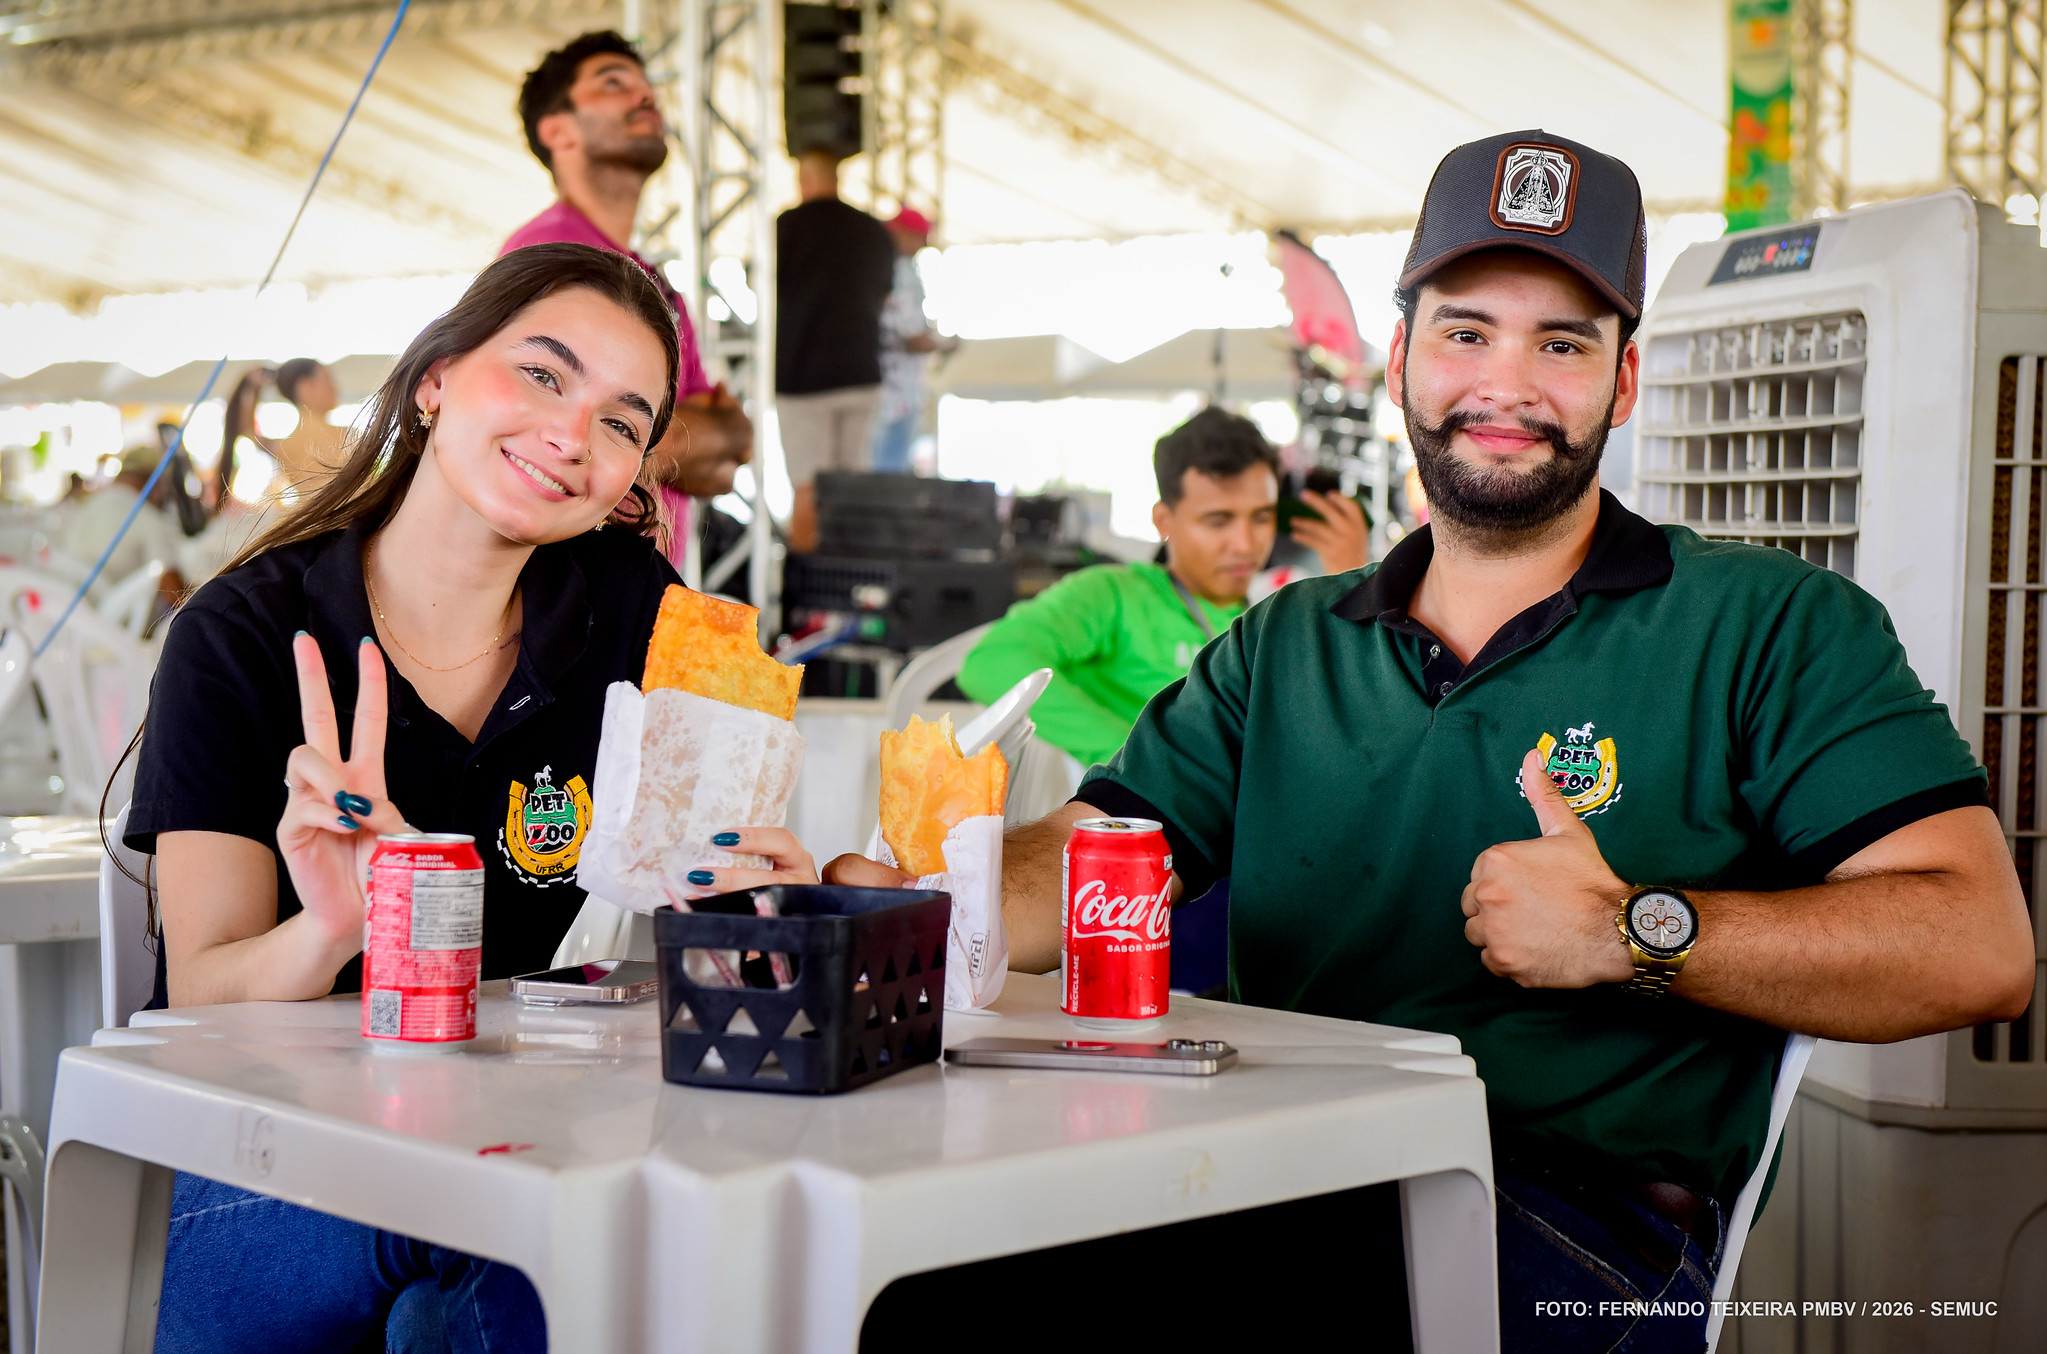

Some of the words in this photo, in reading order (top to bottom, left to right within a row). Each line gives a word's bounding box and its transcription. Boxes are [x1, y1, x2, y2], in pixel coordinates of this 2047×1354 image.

[1559, 748, 1594, 765] PET
[1551, 771, 1595, 790] ZOO
[530, 792, 566, 814] PET
[528, 823, 576, 845] ZOO
[535, 863, 565, 874] UFRR
[1074, 875, 1171, 941] Coca-C
[1145, 940, 1170, 951] ORIGIN
[1072, 955, 1080, 1013] RECICLE-ME
